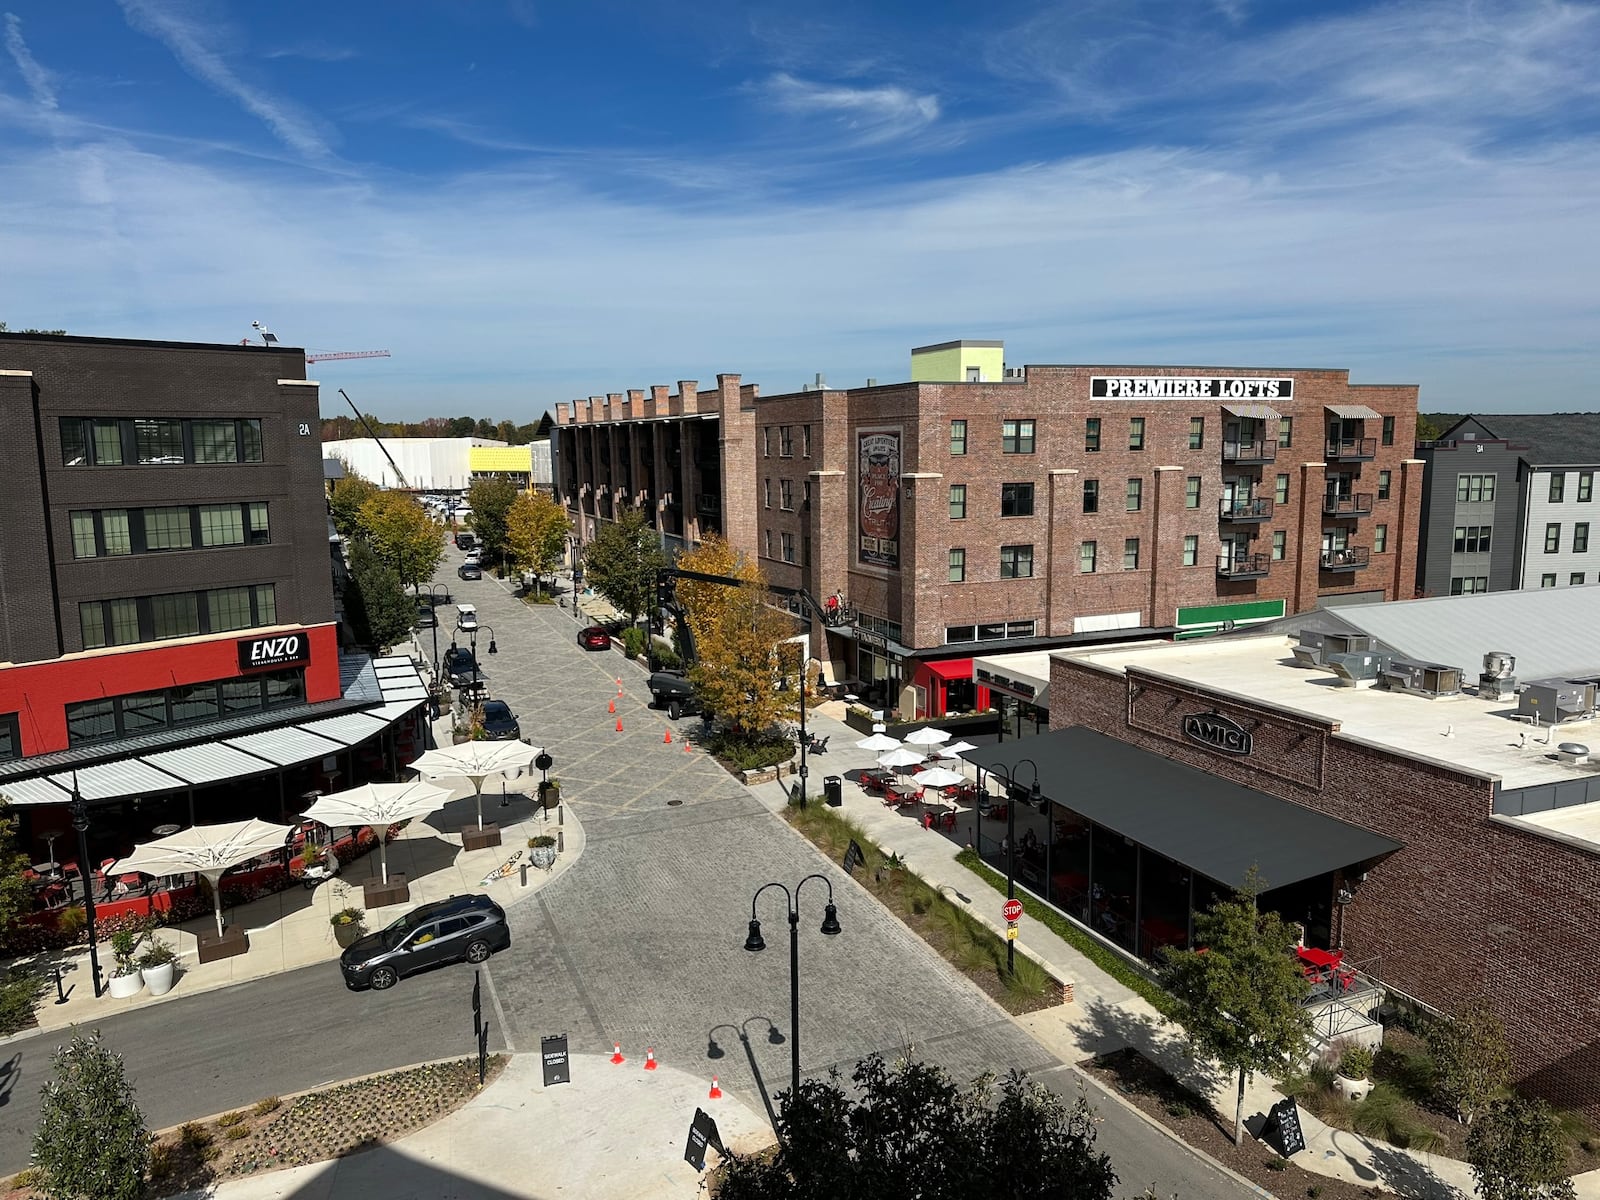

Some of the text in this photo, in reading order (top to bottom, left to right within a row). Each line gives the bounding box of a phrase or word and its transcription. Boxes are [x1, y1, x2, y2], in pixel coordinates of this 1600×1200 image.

[1105, 378, 1280, 398] PREMIERE LOFTS
[299, 423, 310, 435] 2A
[1476, 444, 1484, 453] 3A
[864, 485, 894, 518] Creating
[251, 636, 299, 660] ENZO
[252, 658, 283, 666] STEAKHOUSE
[1189, 718, 1246, 750] AMICI
[1004, 905, 1021, 916] STOP
[544, 1051, 567, 1060] SIDEWALK
